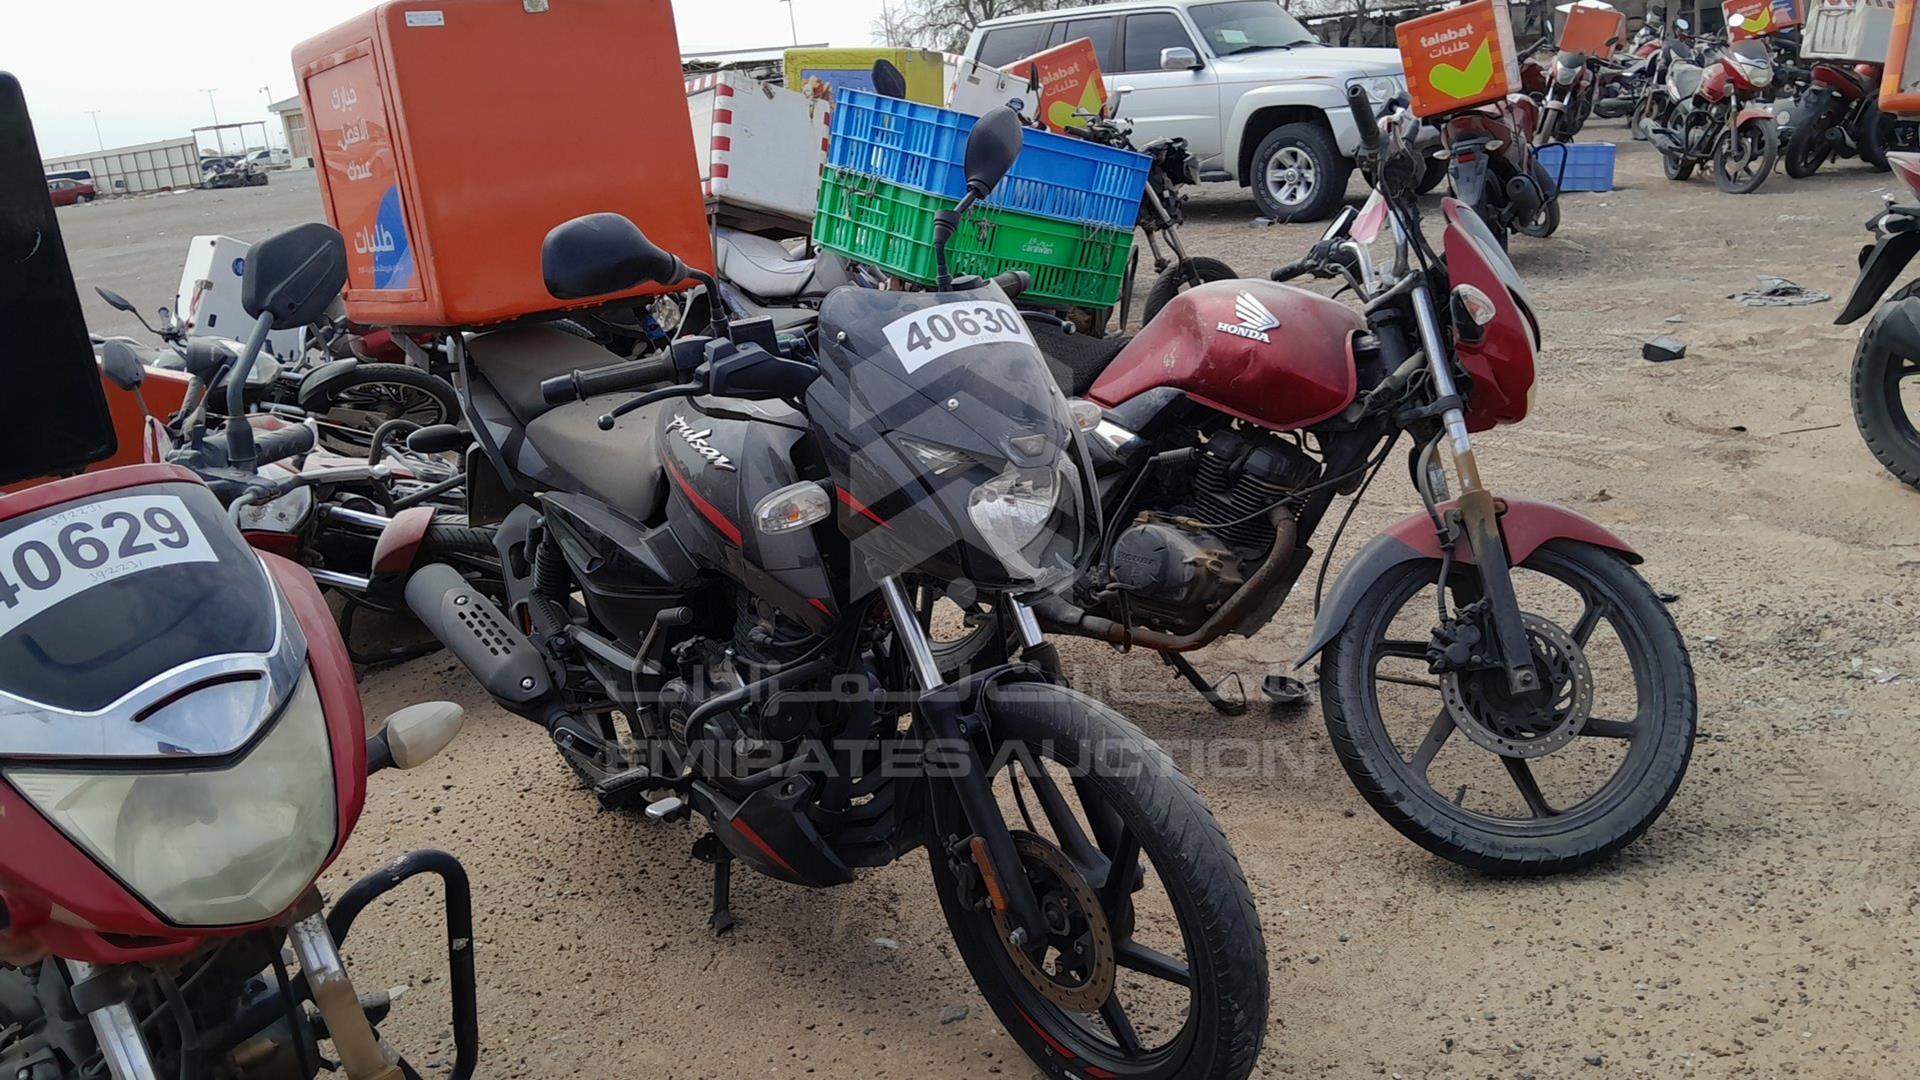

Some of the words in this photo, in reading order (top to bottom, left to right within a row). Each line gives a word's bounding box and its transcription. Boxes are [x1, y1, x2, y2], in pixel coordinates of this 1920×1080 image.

[1420, 24, 1474, 47] talabat
[1429, 41, 1470, 59] طلبات
[1041, 62, 1080, 85] alabat
[1045, 78, 1079, 97] طلبات
[354, 223, 395, 262] طلبات
[906, 307, 1021, 352] 40630
[1216, 322, 1271, 344] HONDA
